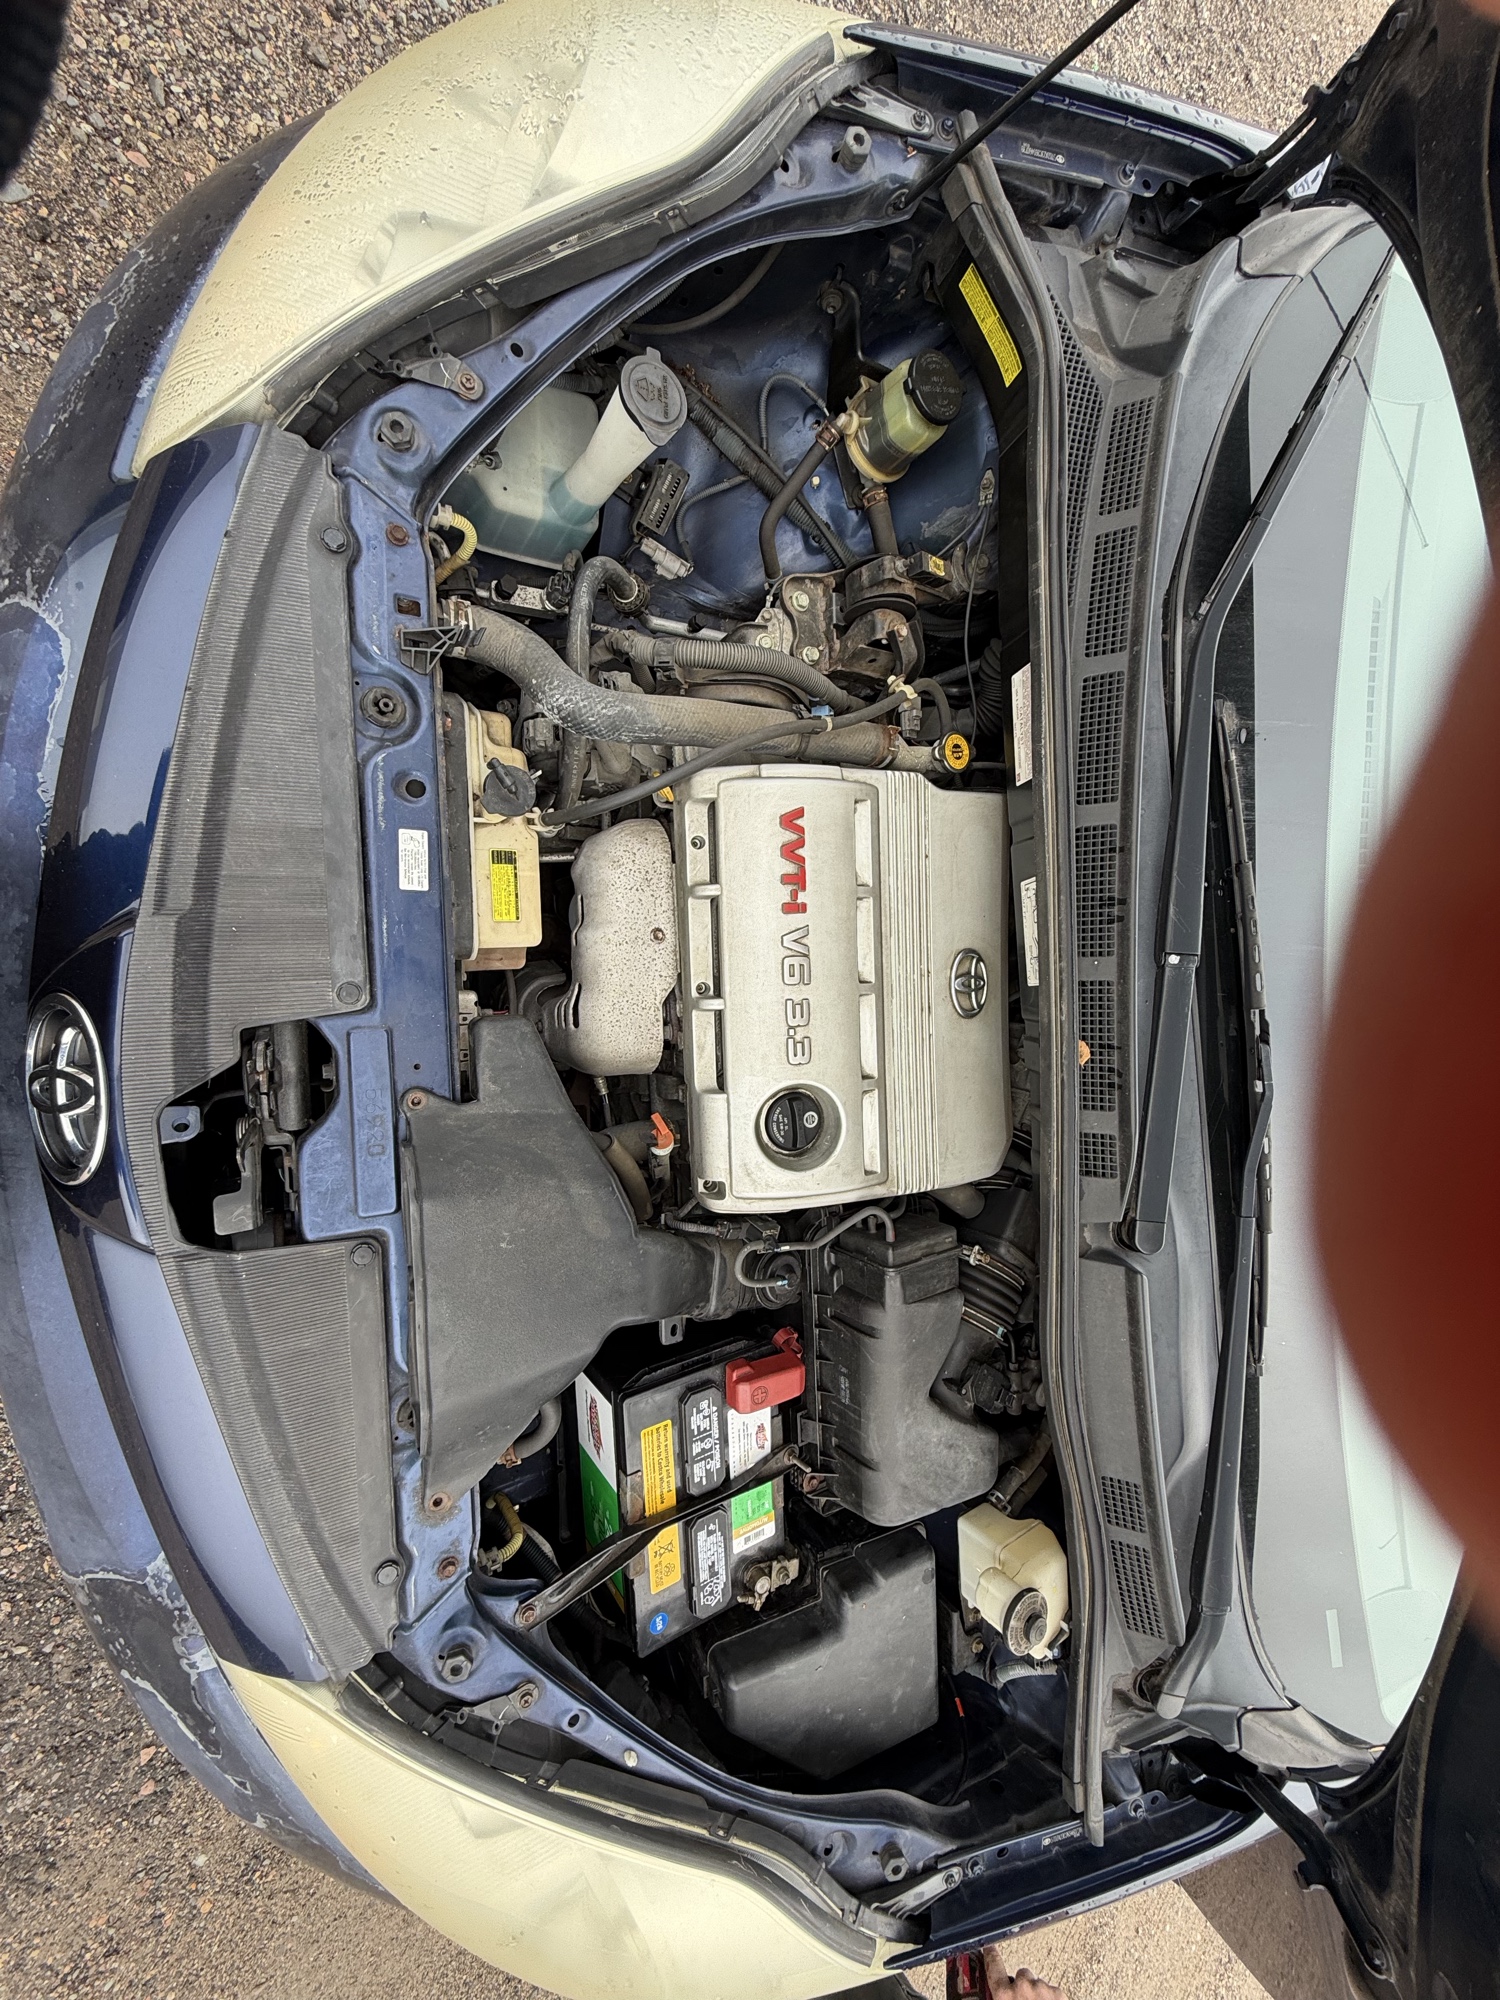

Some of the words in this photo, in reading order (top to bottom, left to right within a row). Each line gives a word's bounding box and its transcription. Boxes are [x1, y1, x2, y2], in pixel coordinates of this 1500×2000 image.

[779, 806, 807, 915] VVT-i
[781, 924, 812, 986] V6
[784, 997, 811, 1066] 3.3
[773, 1107, 781, 1121] ENERGY
[773, 1123, 784, 1143] CONSERVING
[658, 1476, 666, 1504] Wholesale
